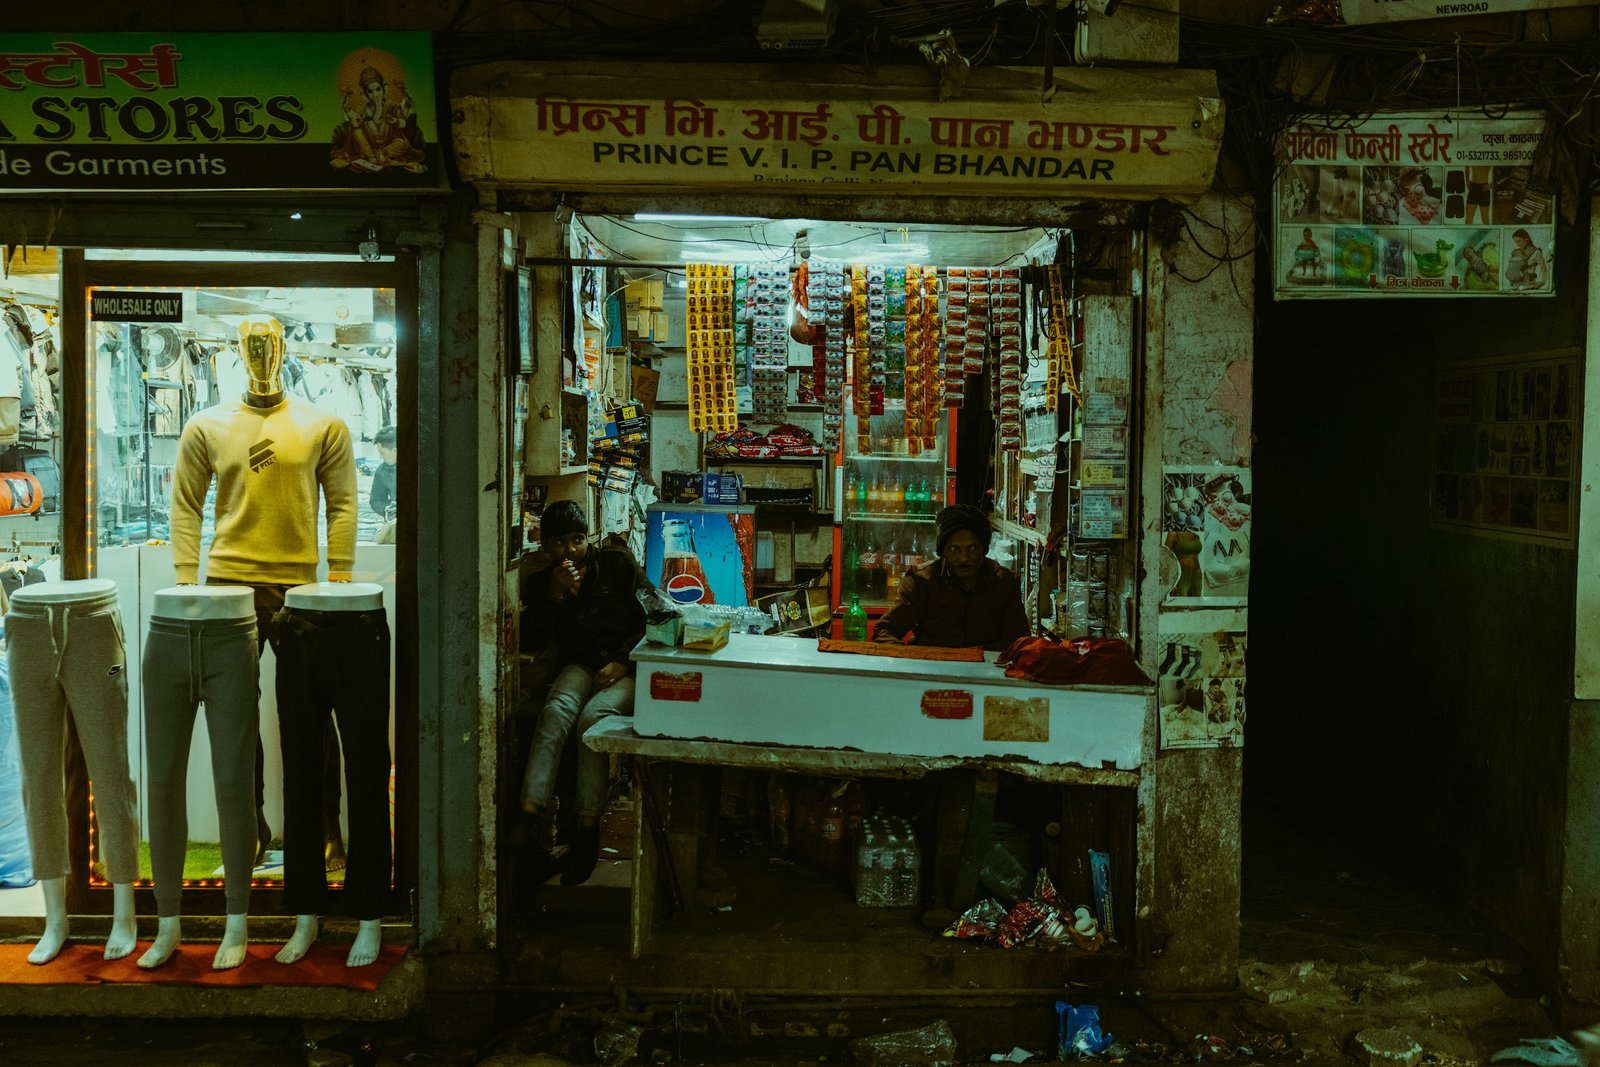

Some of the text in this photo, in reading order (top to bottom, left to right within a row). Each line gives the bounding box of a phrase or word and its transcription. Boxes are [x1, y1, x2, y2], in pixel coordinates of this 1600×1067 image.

[1436, 2, 1489, 15] NEWROAD
[31, 95, 308, 142] STORES
[741, 103, 839, 147] आई.
[856, 104, 911, 145] पी.
[929, 117, 1014, 149] पान
[1027, 120, 1177, 156] भण्डार
[593, 142, 728, 166] PRINCE
[850, 151, 921, 173] PAN
[933, 153, 1115, 181] BHANDAR
[1345, 124, 1402, 162] फेन्सी
[1408, 123, 1454, 163] स्टोर
[45, 150, 227, 176] Garments
[94, 297, 180, 316] WHOLESALE ONLY
